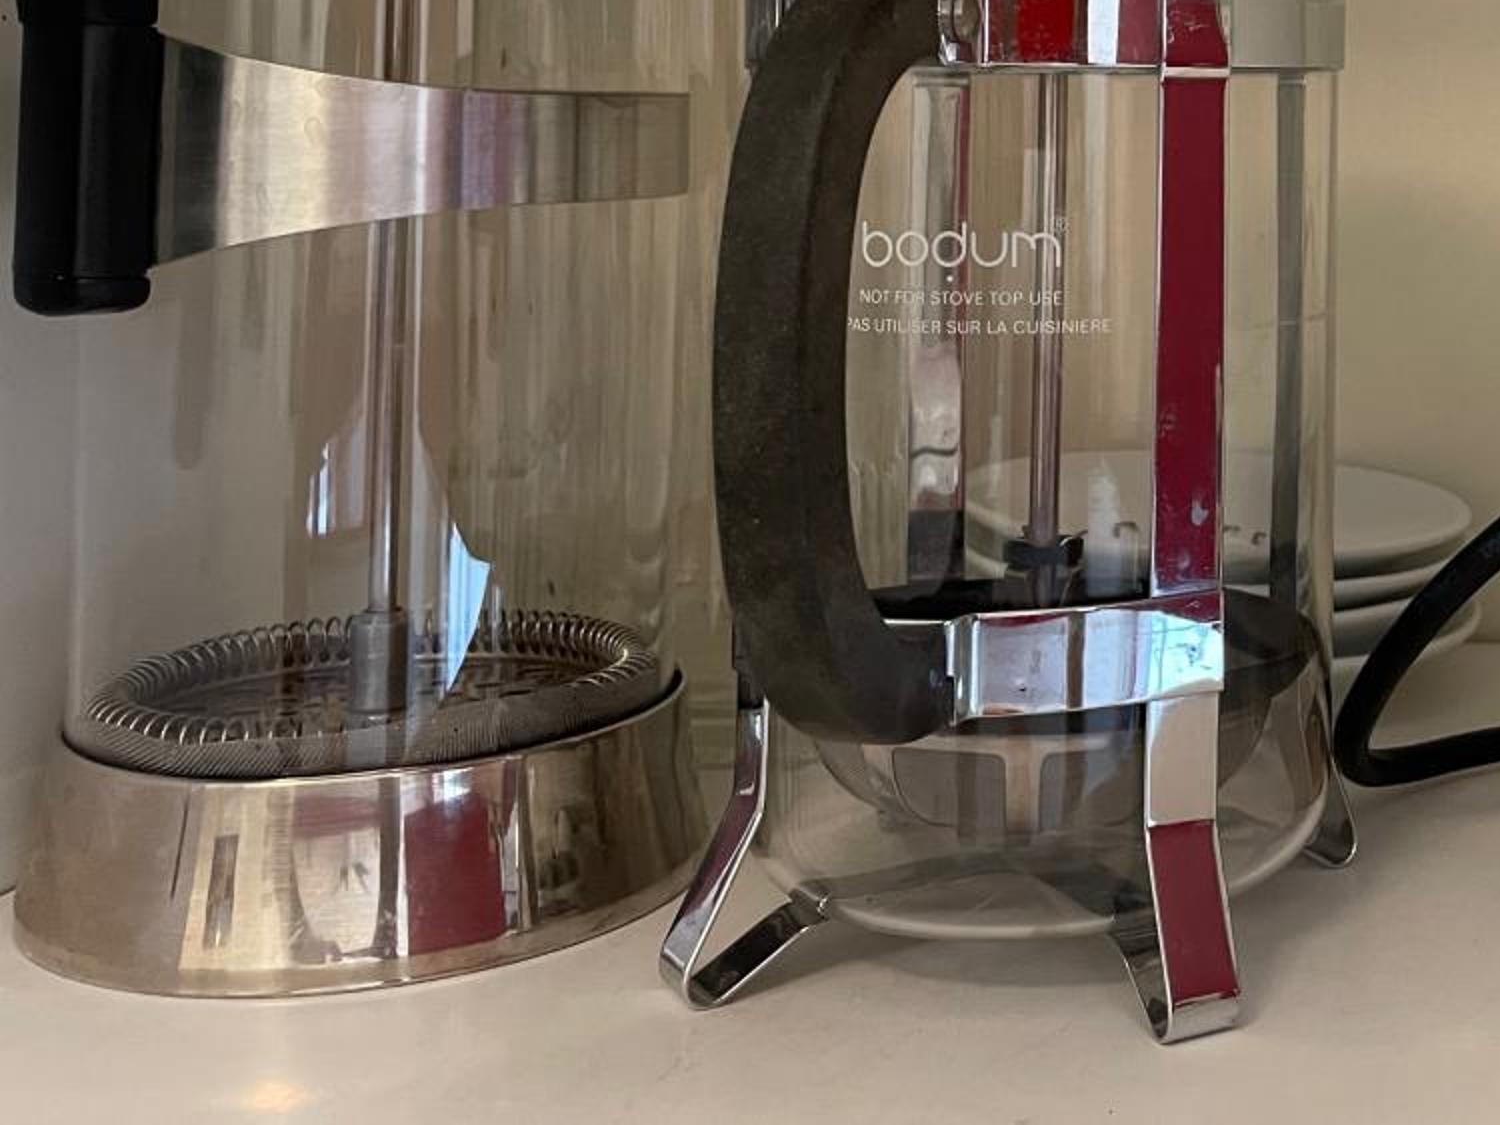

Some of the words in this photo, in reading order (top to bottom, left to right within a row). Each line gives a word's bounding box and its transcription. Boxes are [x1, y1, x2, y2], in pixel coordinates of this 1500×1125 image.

[862, 221, 1062, 283] bodum
[860, 289, 890, 304] NOT
[894, 290, 925, 304] FOR
[930, 290, 984, 306] STOVE
[990, 291, 1023, 306] TOP
[1029, 291, 1064, 306] USE
[875, 318, 942, 334] UTILISER
[946, 321, 981, 335] SUR
[987, 321, 1007, 335] LA
[1013, 319, 1113, 335] CUISINIERE
